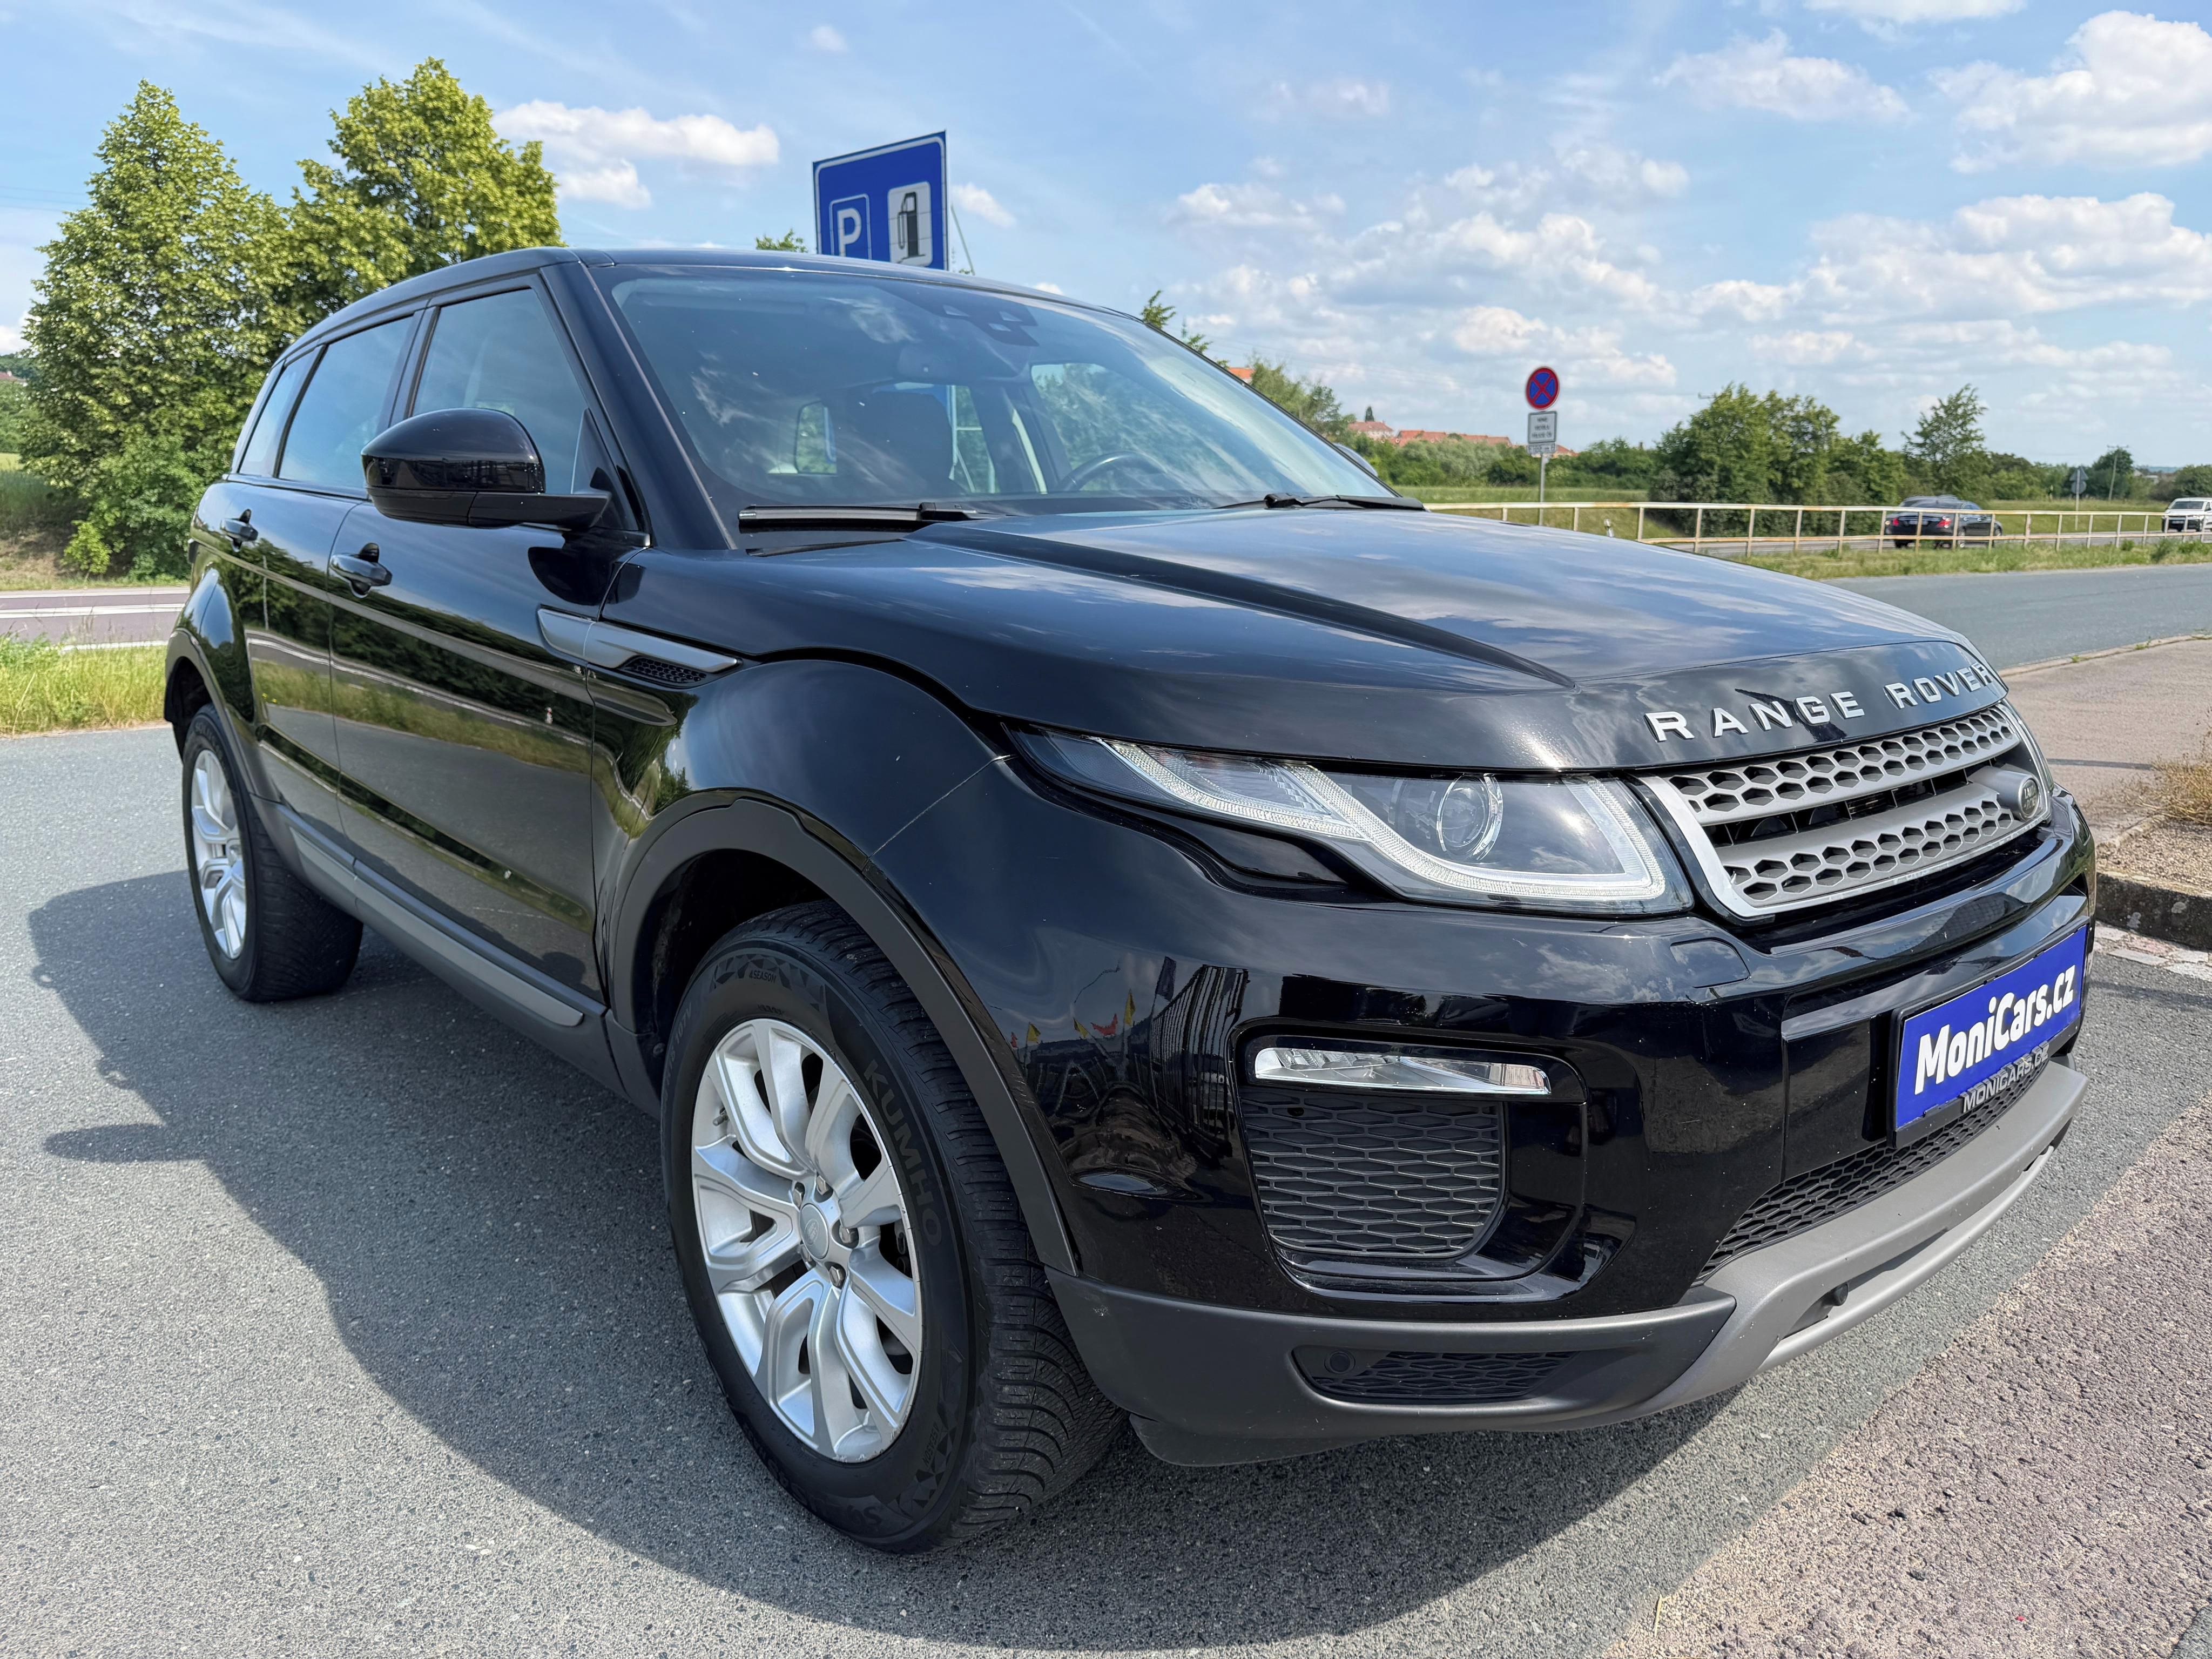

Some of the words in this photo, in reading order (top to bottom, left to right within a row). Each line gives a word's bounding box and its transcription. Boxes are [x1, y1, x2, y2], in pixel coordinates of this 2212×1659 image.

[838, 207, 862, 257] P
[1645, 691, 1865, 742] RANGE
[1884, 662, 1993, 709] ROVER
[749, 970, 777, 983] 4SEASON
[1960, 1042, 2050, 1113] MONICARS.CZ
[864, 1059, 942, 1246] KUMHO
